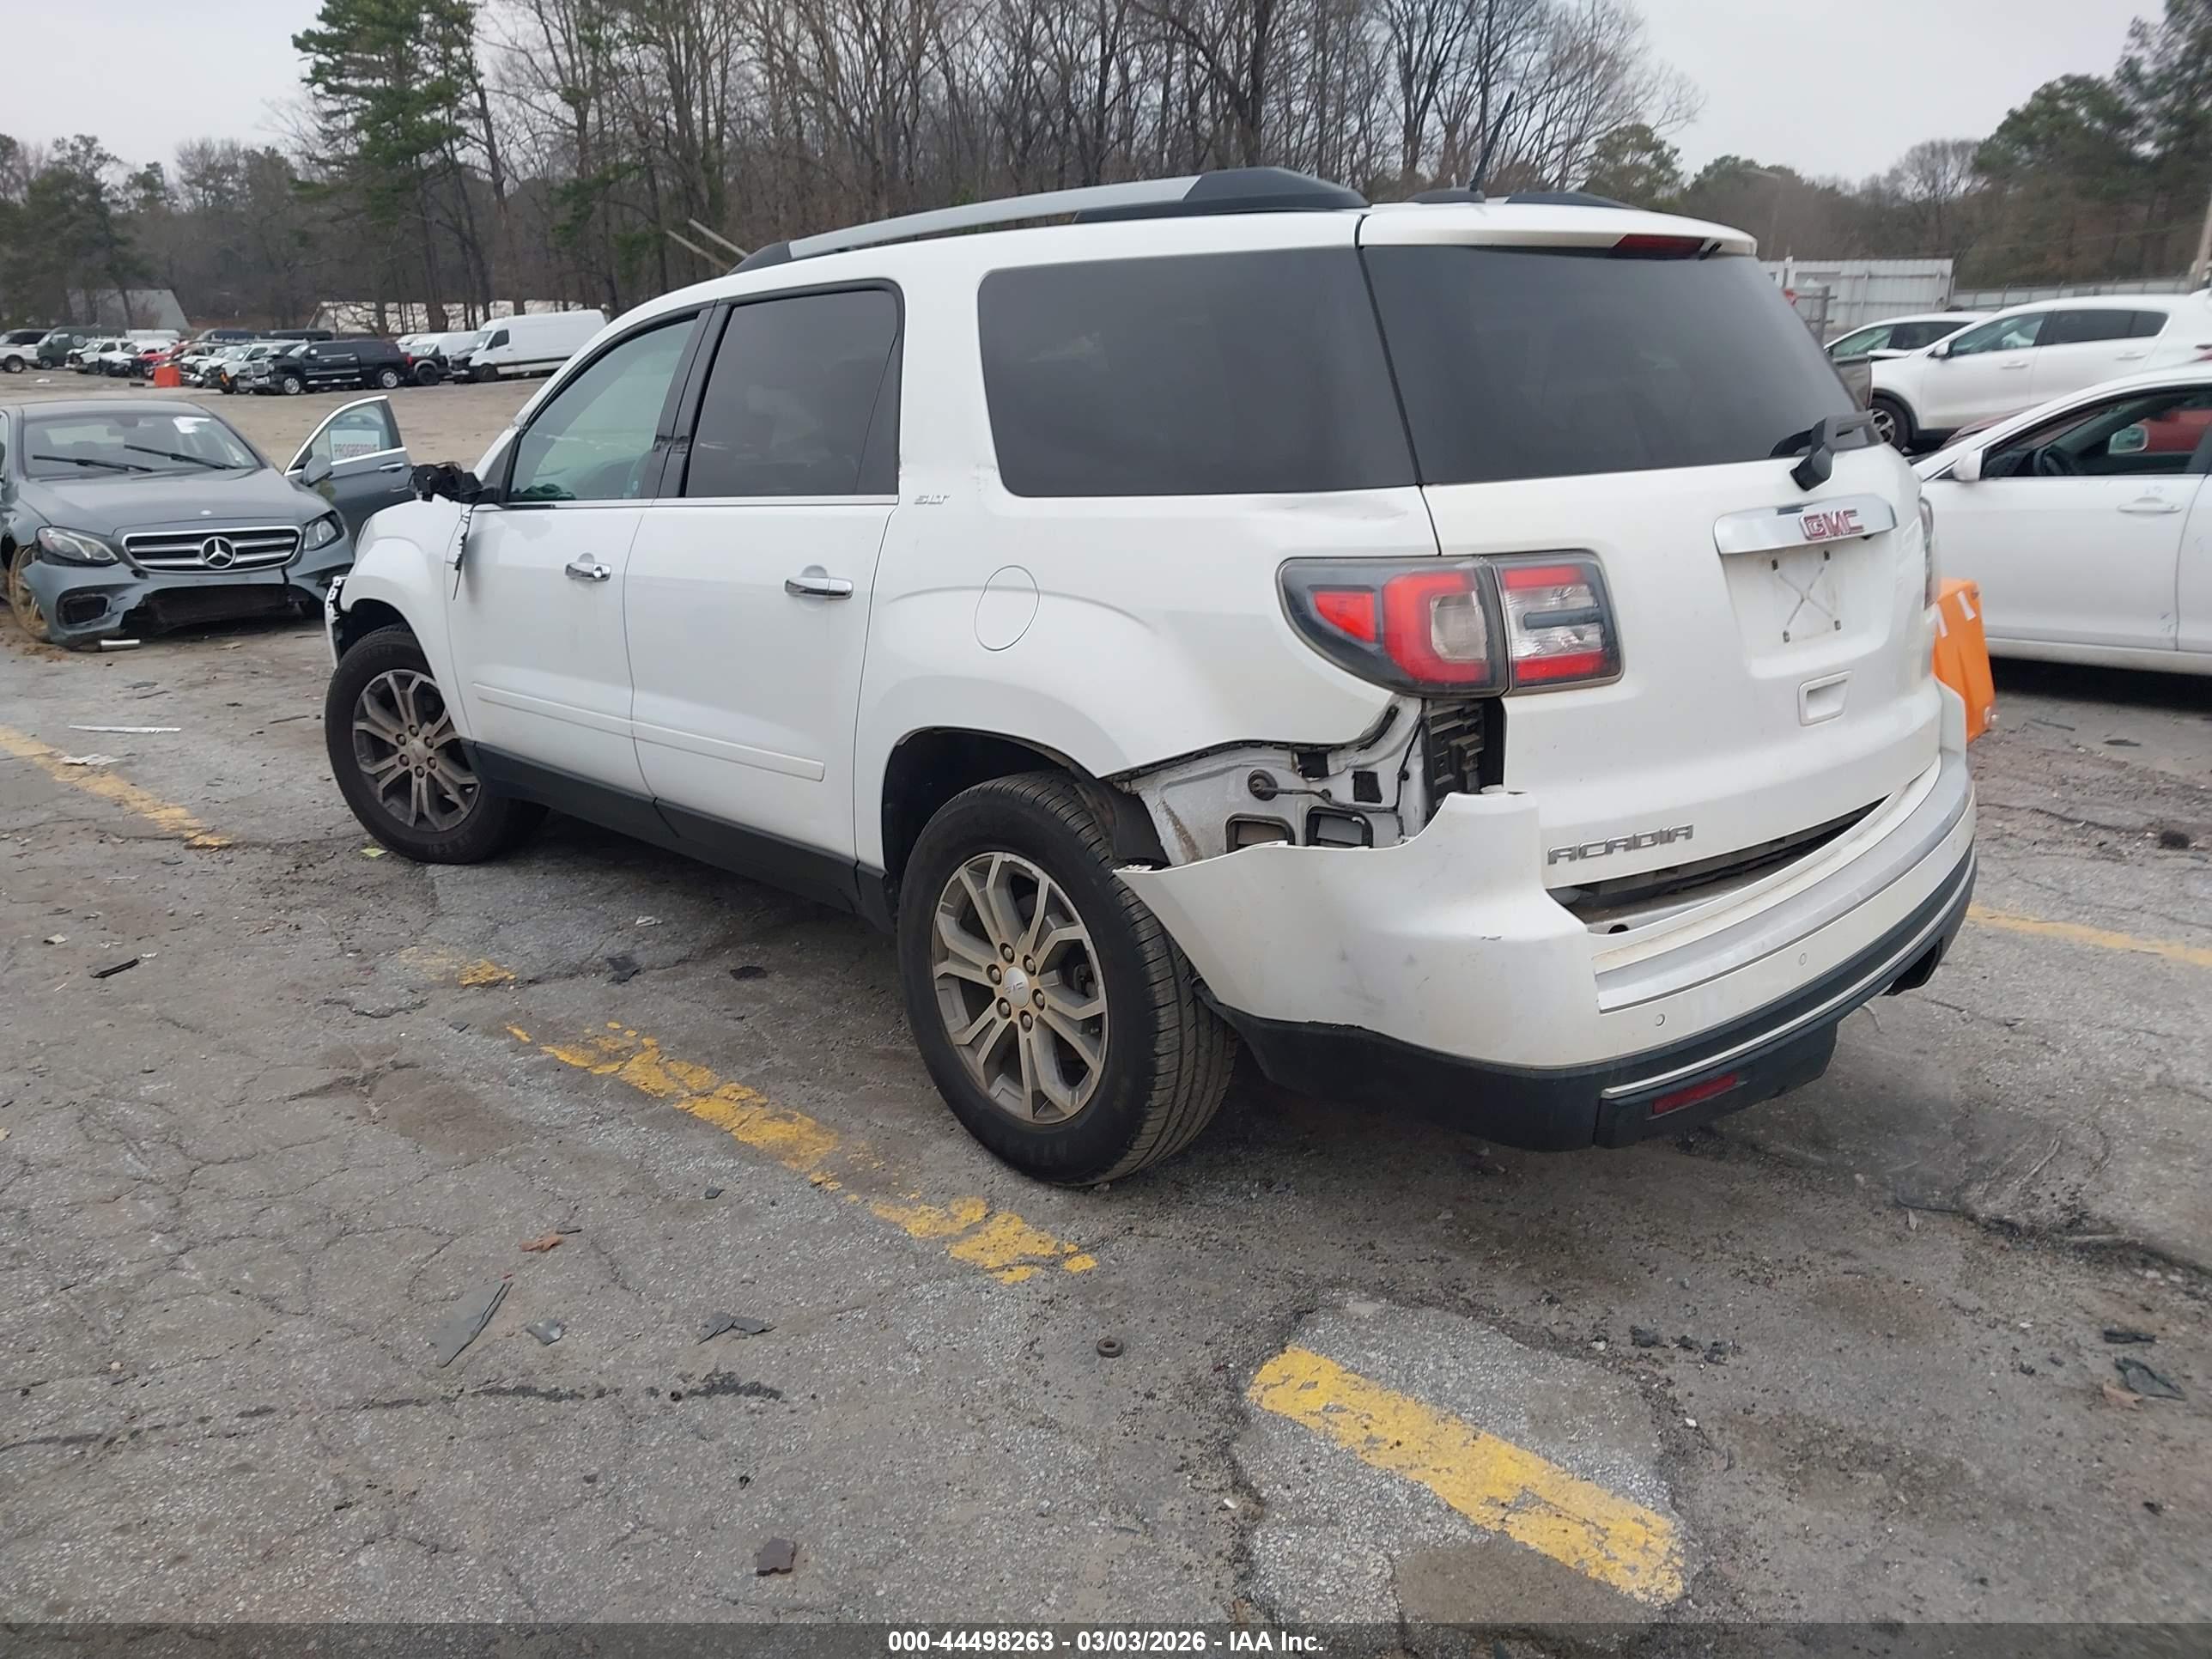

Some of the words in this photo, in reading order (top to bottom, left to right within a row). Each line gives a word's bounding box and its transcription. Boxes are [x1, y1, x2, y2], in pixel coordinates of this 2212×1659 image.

[914, 494, 951, 505] SLT
[1799, 508, 1864, 540] GMC
[1547, 823, 1694, 866] ACADIA
